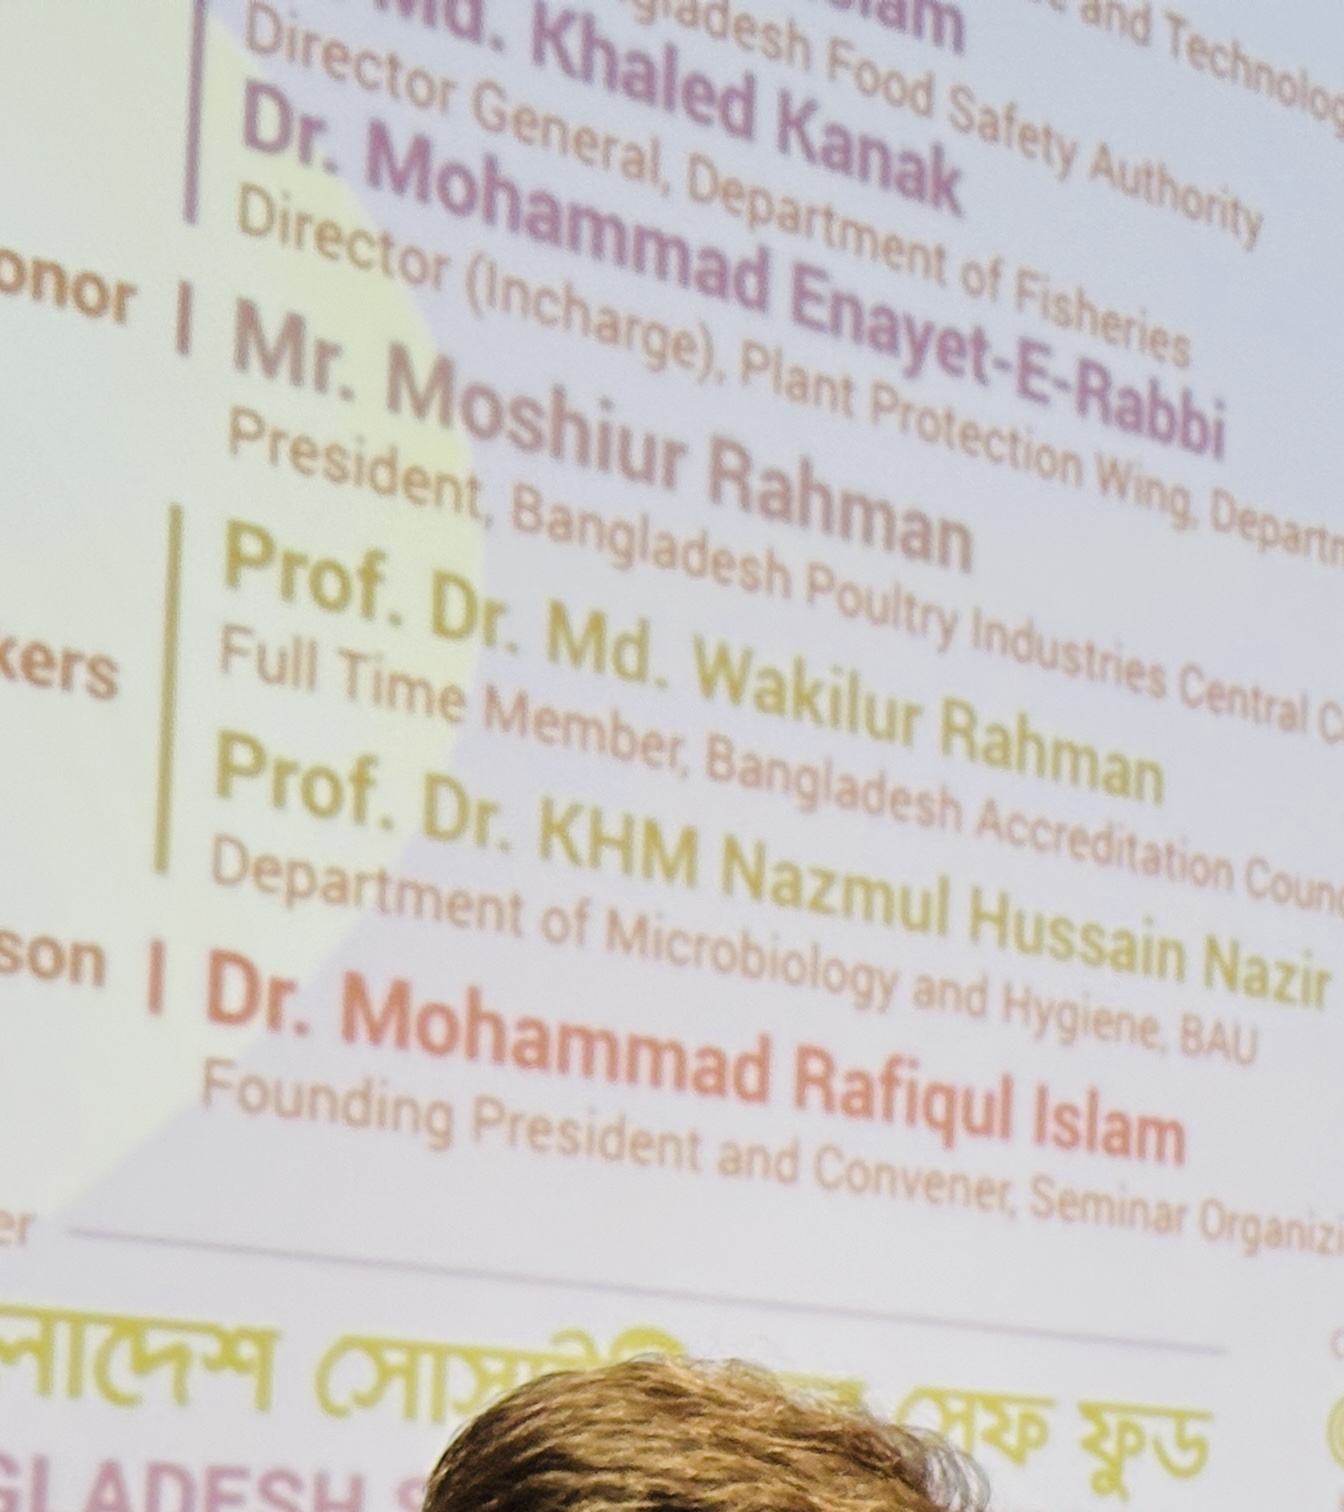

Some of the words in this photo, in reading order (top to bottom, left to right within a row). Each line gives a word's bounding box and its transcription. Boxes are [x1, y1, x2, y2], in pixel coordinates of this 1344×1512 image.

[246, 0, 458, 112] Director
[472, 80, 672, 198] General,
[687, 153, 947, 286] Department
[962, 257, 1003, 302] of
[1017, 266, 1192, 369] Fisheries
[533, 0, 756, 142] Khaled
[777, 87, 965, 219] Kanak
[827, 38, 934, 118] Food
[949, 85, 1076, 182] Safety
[1090, 144, 1264, 253] Authority
[238, 182, 453, 291] Director
[467, 252, 726, 388] (Incharge),
[740, 338, 856, 419] Plant
[870, 380, 1085, 488] Protection
[1094, 451, 1200, 533] Wing,
[242, 78, 340, 176] Dr.
[366, 116, 773, 316] Mohammad
[790, 262, 1227, 462] Enayet-E-Rabbi
[228, 406, 494, 529] President,
[511, 484, 793, 602] Bangladesh
[806, 561, 959, 653] Poultry
[971, 607, 1168, 700] Industries
[1178, 663, 1309, 735] Central
[232, 297, 356, 404] Mr.
[385, 340, 690, 494] Moshiur
[708, 435, 975, 576] Rahman
[218, 622, 318, 694] Full
[336, 647, 467, 724] Time
[482, 684, 692, 780] Member,
[705, 735, 964, 834] Bangladesh
[975, 799, 1235, 893] Accreditation
[224, 519, 404, 628] Prof.
[430, 569, 519, 657] Dr.
[547, 597, 668, 689] Md.
[691, 633, 923, 748] Wakilur
[940, 698, 1166, 808] Rahman
[209, 833, 524, 938] Department
[540, 898, 590, 946] of
[605, 907, 900, 1015] Microbiology
[911, 967, 989, 1021] and
[1000, 976, 1168, 1057] Hygiene,
[1179, 1014, 1261, 1068] BAU
[215, 729, 396, 832] Prof.
[421, 771, 512, 852] Dr.
[538, 795, 700, 891] KHM
[720, 832, 951, 939] Nazmul
[968, 884, 1187, 984] Hussain
[1203, 933, 1334, 1012] Nazir
[200, 1056, 455, 1153] Founding
[473, 1095, 702, 1174] President
[717, 1126, 798, 1187] and
[814, 1145, 1017, 1221] Convener,
[1030, 1173, 1189, 1236] Seminar
[206, 948, 310, 1036] Dr.
[339, 968, 773, 1106] Mohammad
[794, 1042, 1013, 1149] Rafiqul
[1033, 1085, 1188, 1166] Islam
